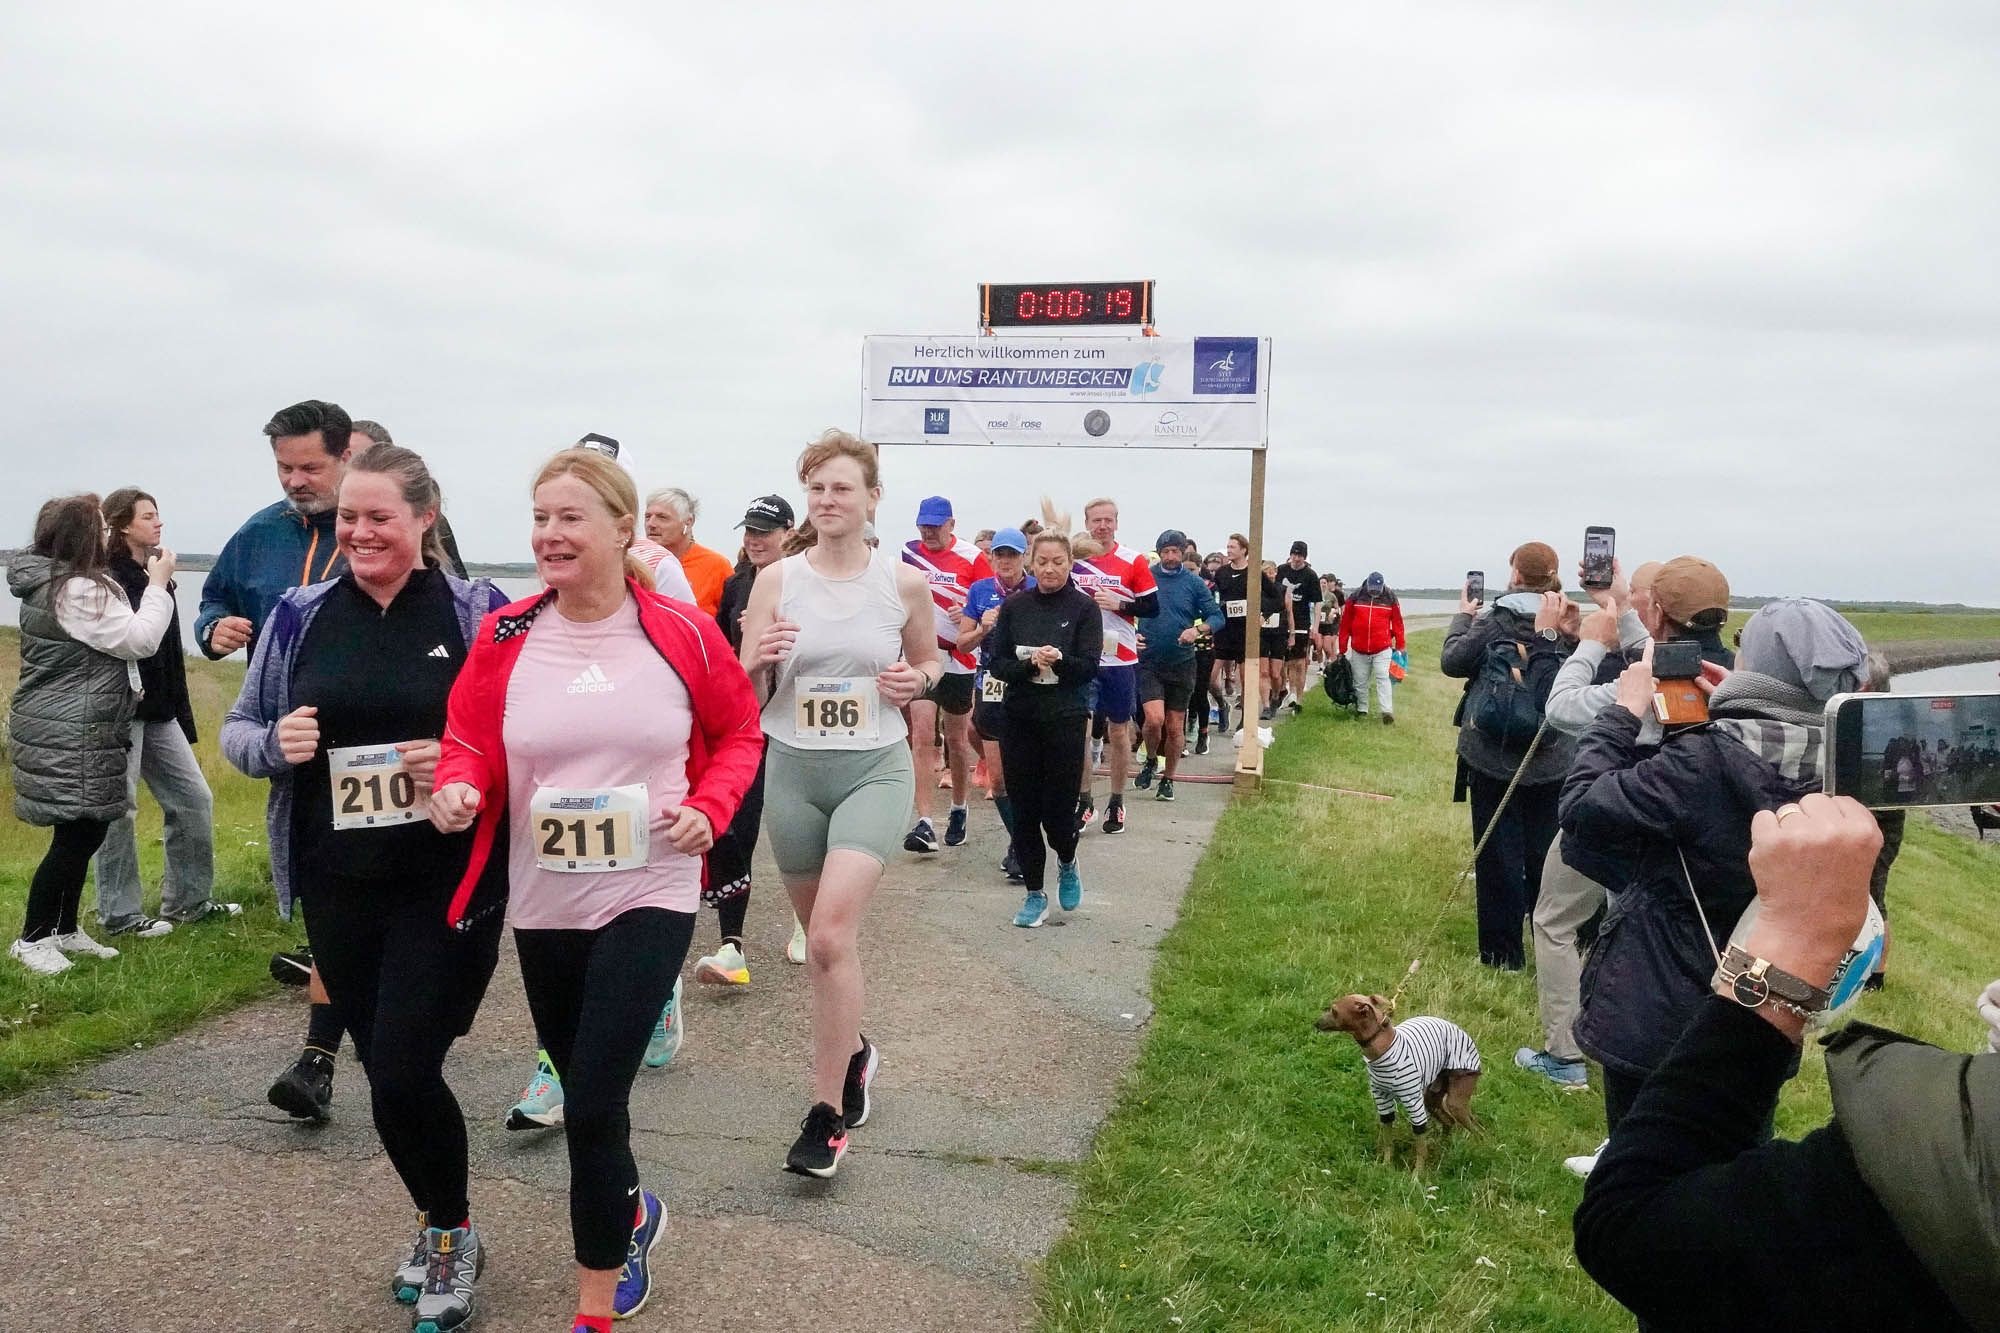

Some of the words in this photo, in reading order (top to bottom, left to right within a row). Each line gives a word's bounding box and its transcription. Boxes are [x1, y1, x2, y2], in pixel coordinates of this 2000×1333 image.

[914, 344, 974, 359] Herzlich
[978, 346, 1069, 360] willkommen
[1073, 349, 1106, 360] zum
[891, 368, 931, 384] RUN
[934, 369, 974, 385] UMS
[977, 369, 1129, 387] RANTUMBECKEN
[987, 420, 1009, 429] rose
[1020, 420, 1042, 429] rose
[1154, 424, 1199, 434] RANTUM
[934, 573, 955, 584] Software
[1100, 576, 1120, 586] Software
[1228, 605, 1244, 615] 109
[566, 677, 616, 695] adidas
[802, 699, 859, 728] 186
[340, 771, 416, 814] 210
[540, 817, 616, 857] 211
